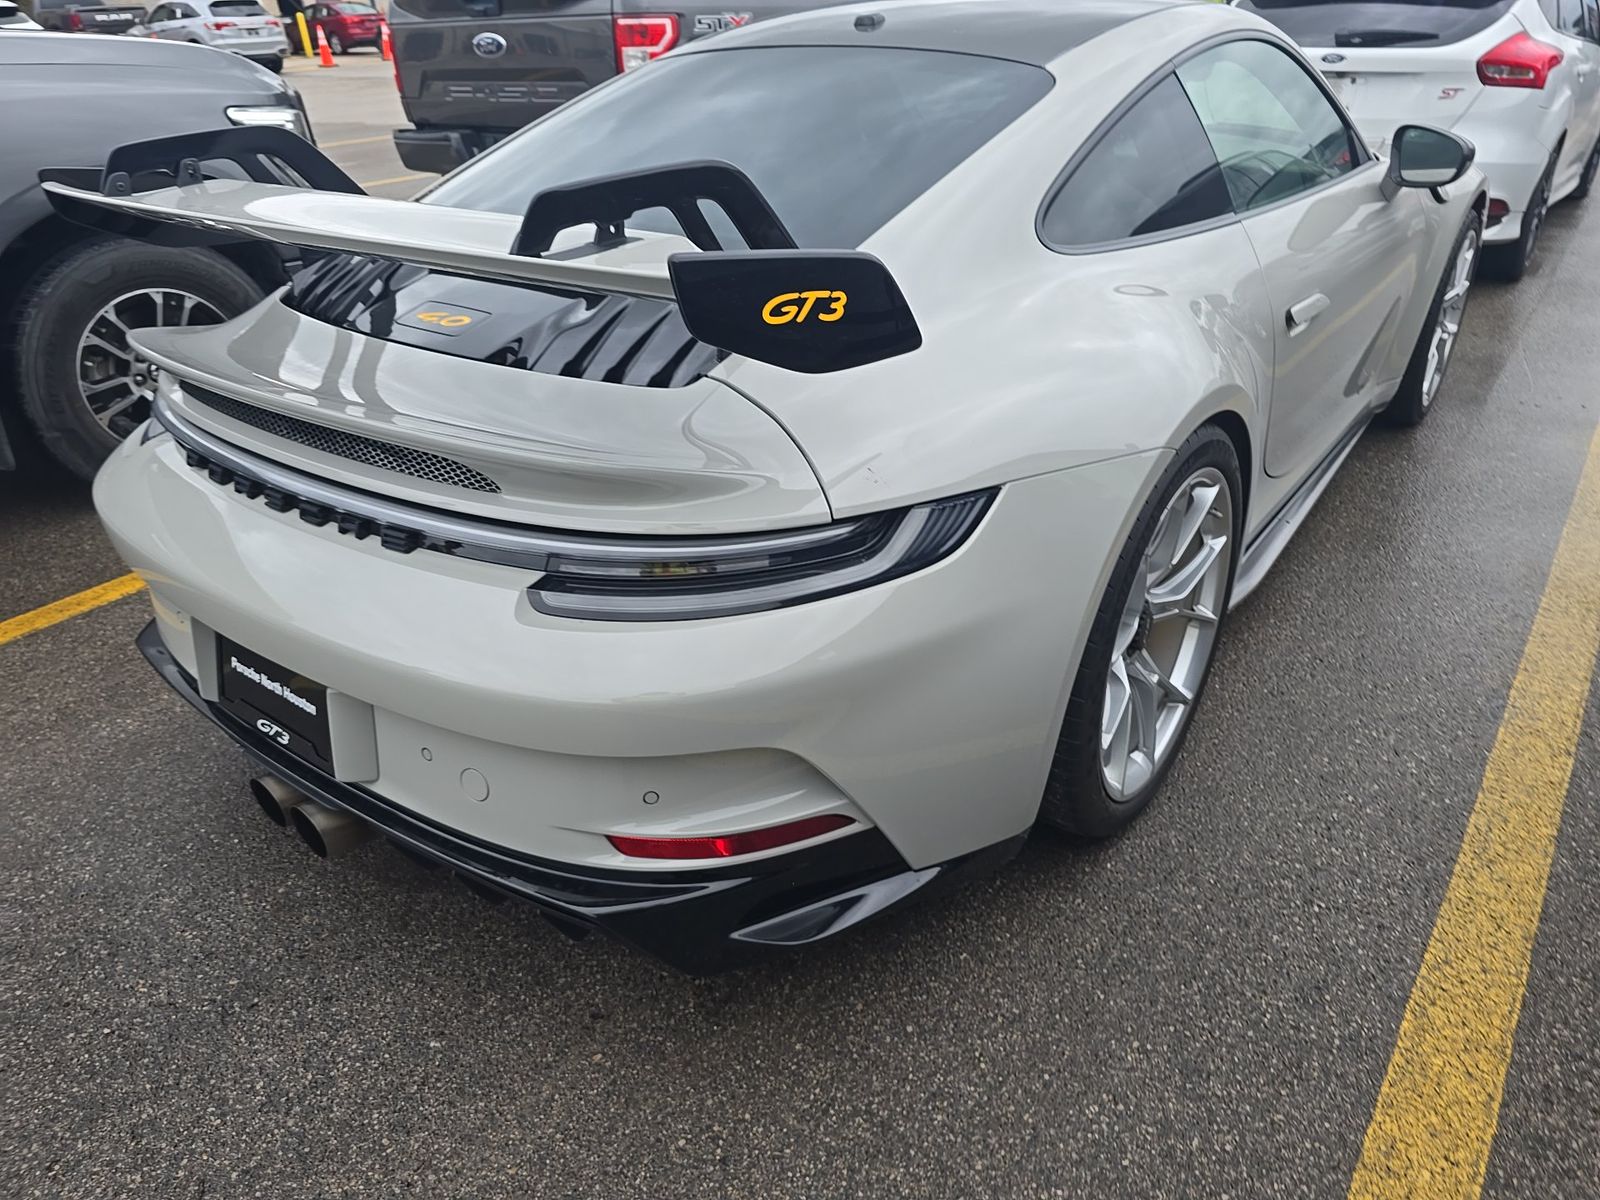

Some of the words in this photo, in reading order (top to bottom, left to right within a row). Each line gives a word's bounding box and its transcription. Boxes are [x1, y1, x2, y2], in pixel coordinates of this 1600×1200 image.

[1438, 87, 1465, 100] ST
[762, 290, 848, 325] GT3
[256, 719, 290, 745] GT3
